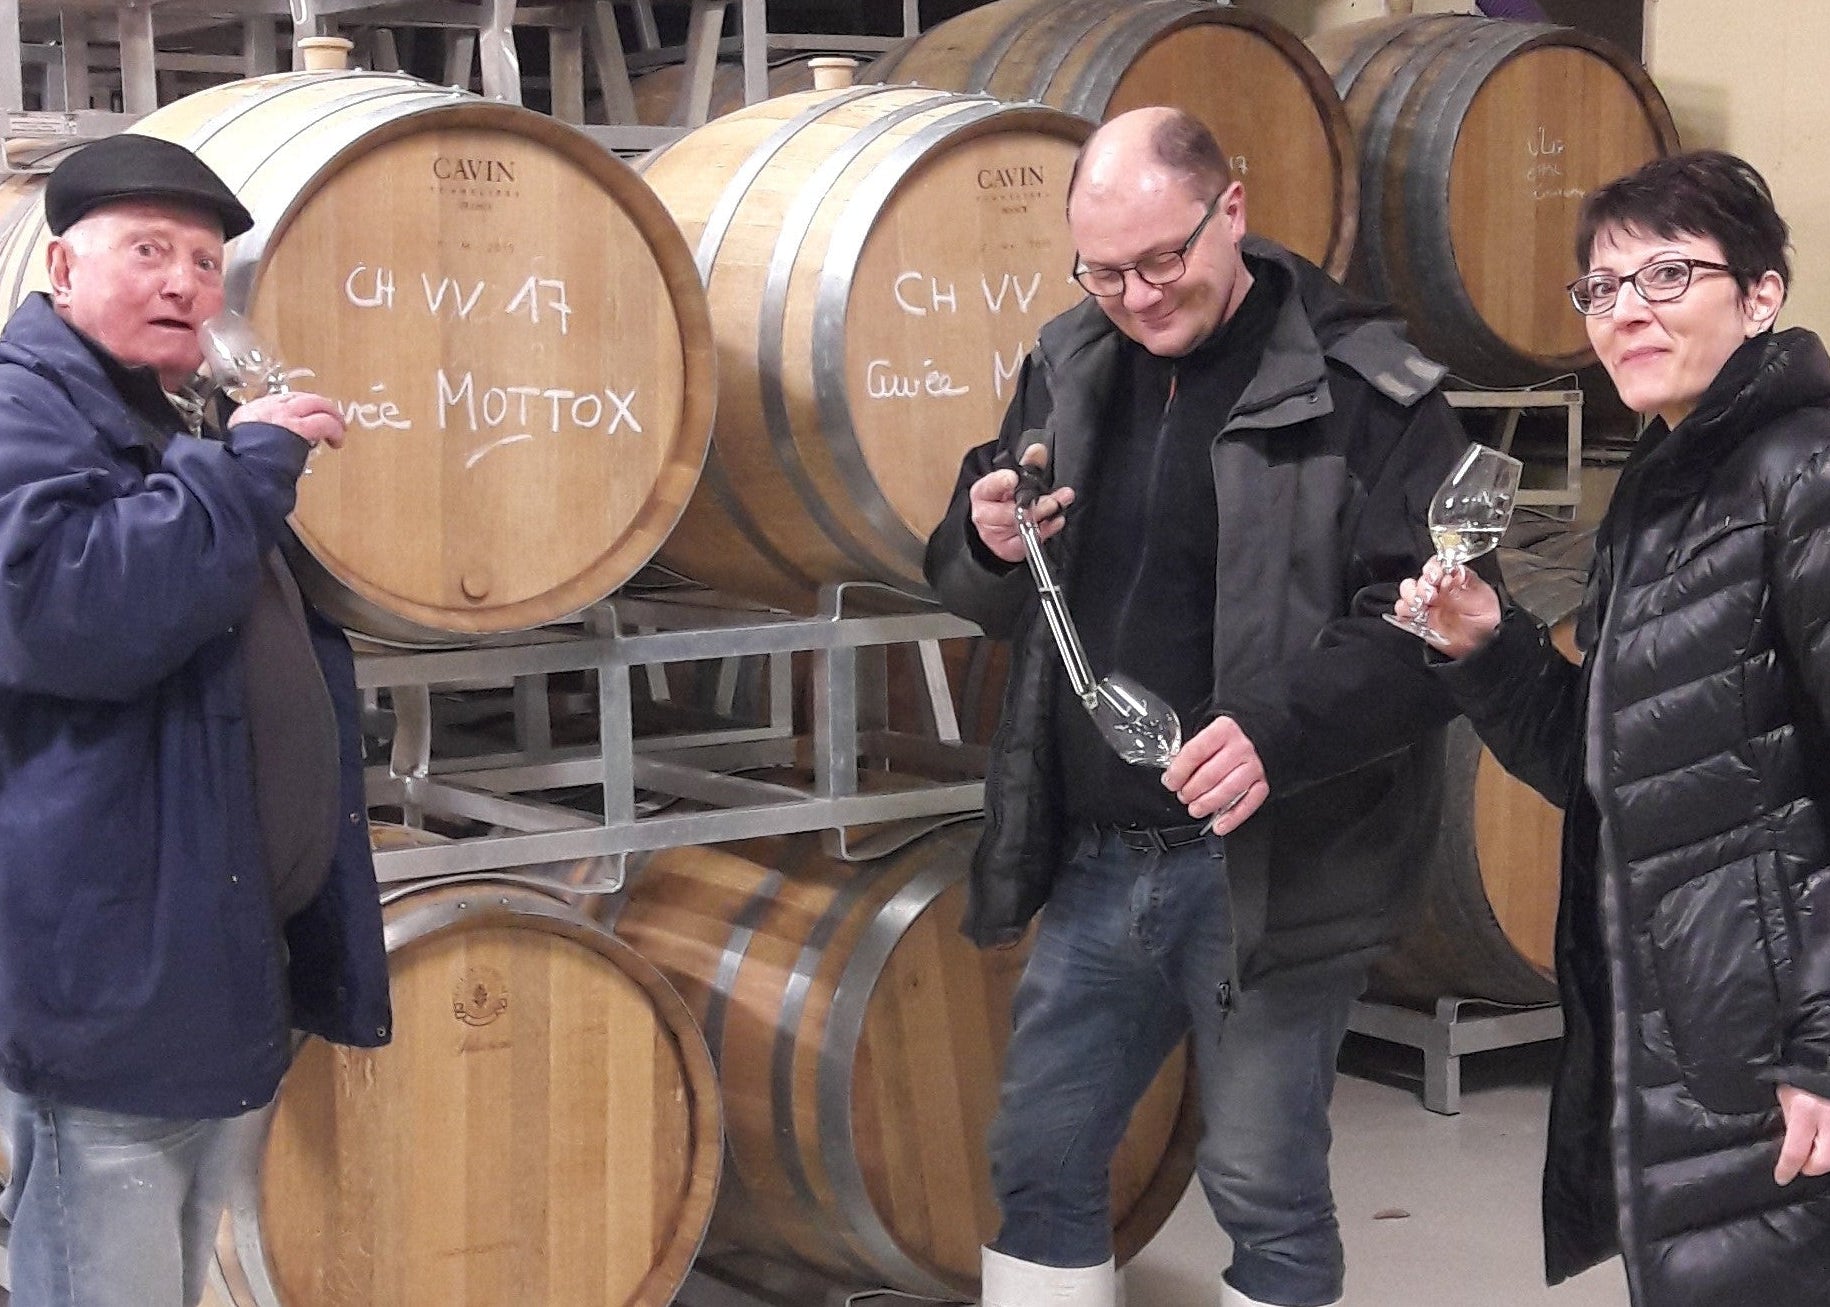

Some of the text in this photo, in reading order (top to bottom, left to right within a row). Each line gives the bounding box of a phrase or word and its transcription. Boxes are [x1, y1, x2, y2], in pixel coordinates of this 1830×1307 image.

[433, 157, 515, 182] CAVIN
[977, 166, 1044, 189] CAVIN
[345, 261, 396, 310] CH
[504, 275, 572, 335] 17
[894, 271, 957, 316] CH
[437, 368, 643, 434] MOTTOX
